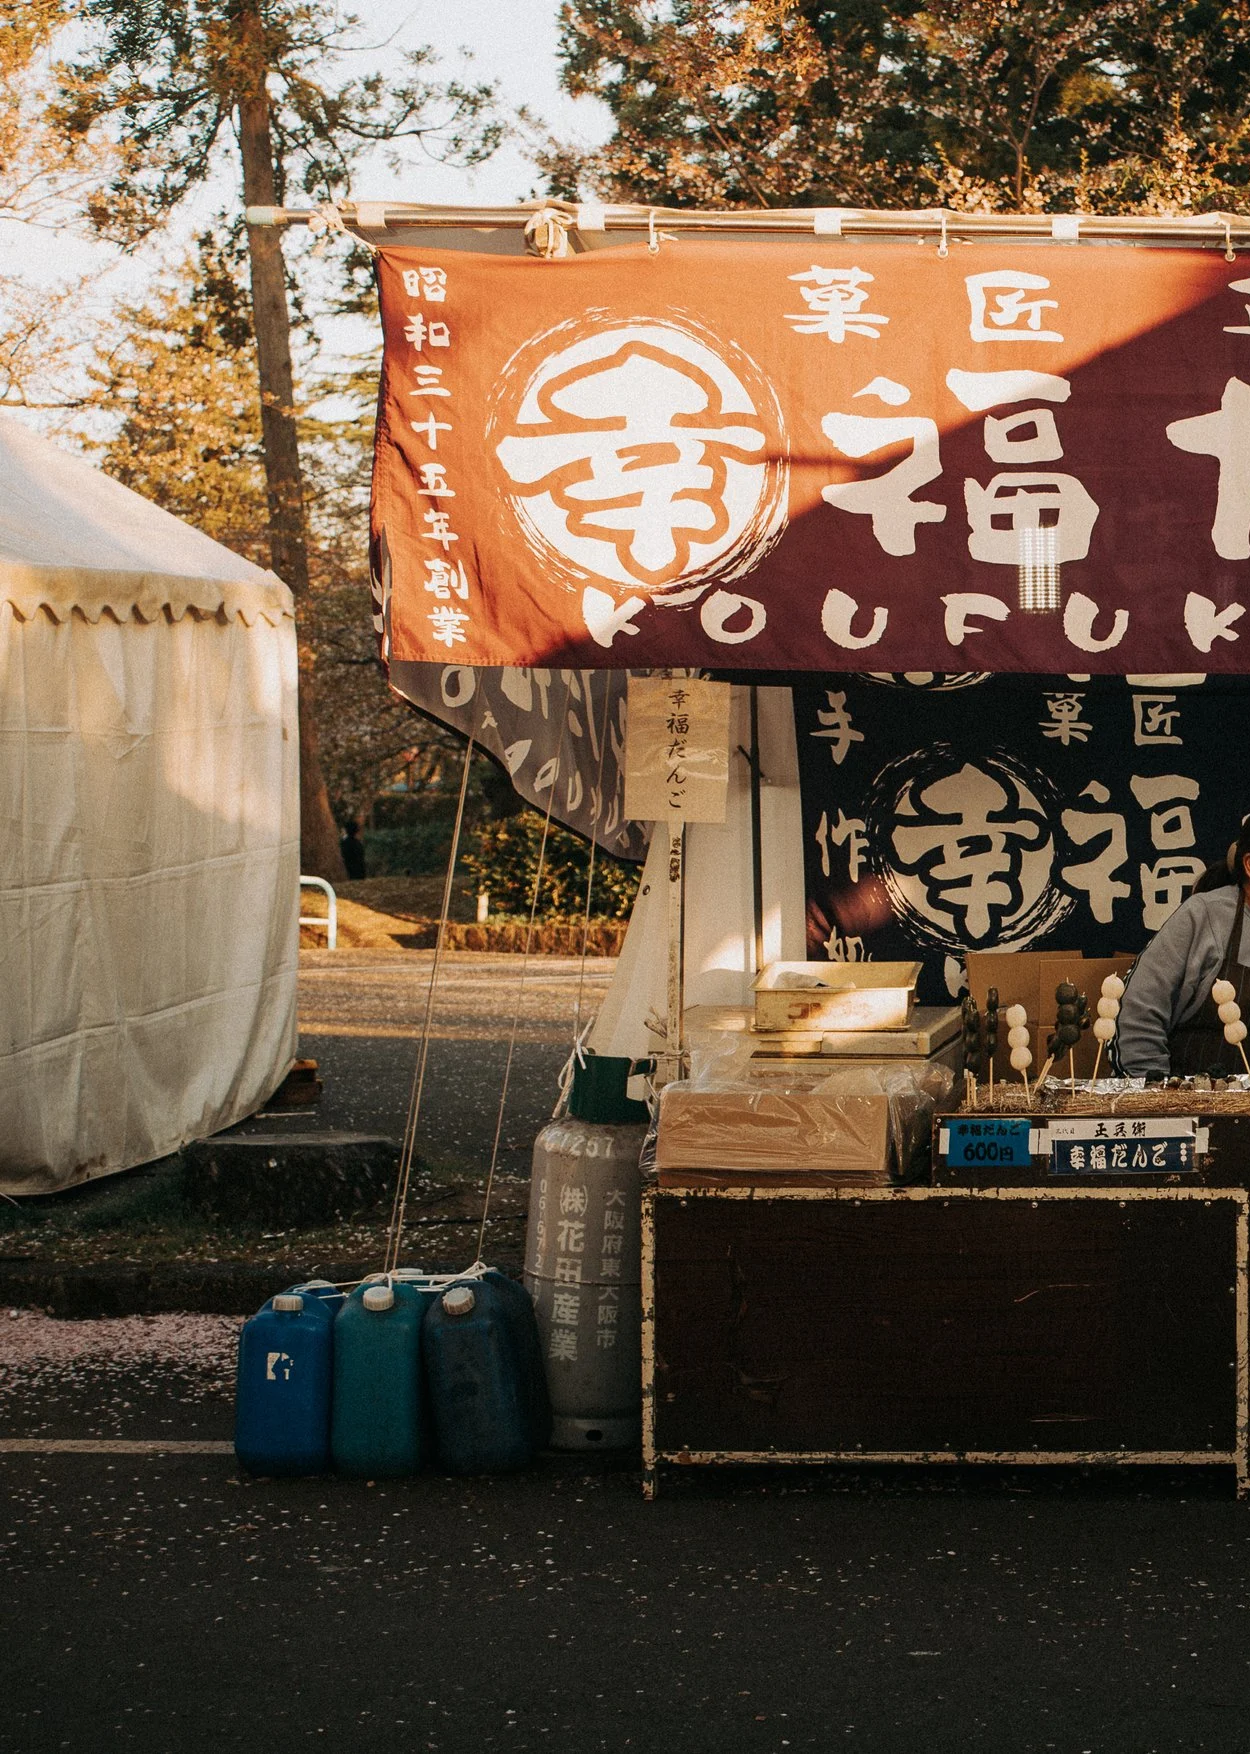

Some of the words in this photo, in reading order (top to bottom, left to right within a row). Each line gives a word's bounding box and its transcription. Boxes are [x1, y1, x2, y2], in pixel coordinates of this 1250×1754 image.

[400, 266, 470, 650] 昭和三十五年創業
[666, 689, 690, 808] 幸福だんご
[963, 1141, 1014, 1162] 600円
[1069, 1140, 1169, 1170] 幸福だんご
[595, 1188, 627, 1350] 大阪府東大阪市
